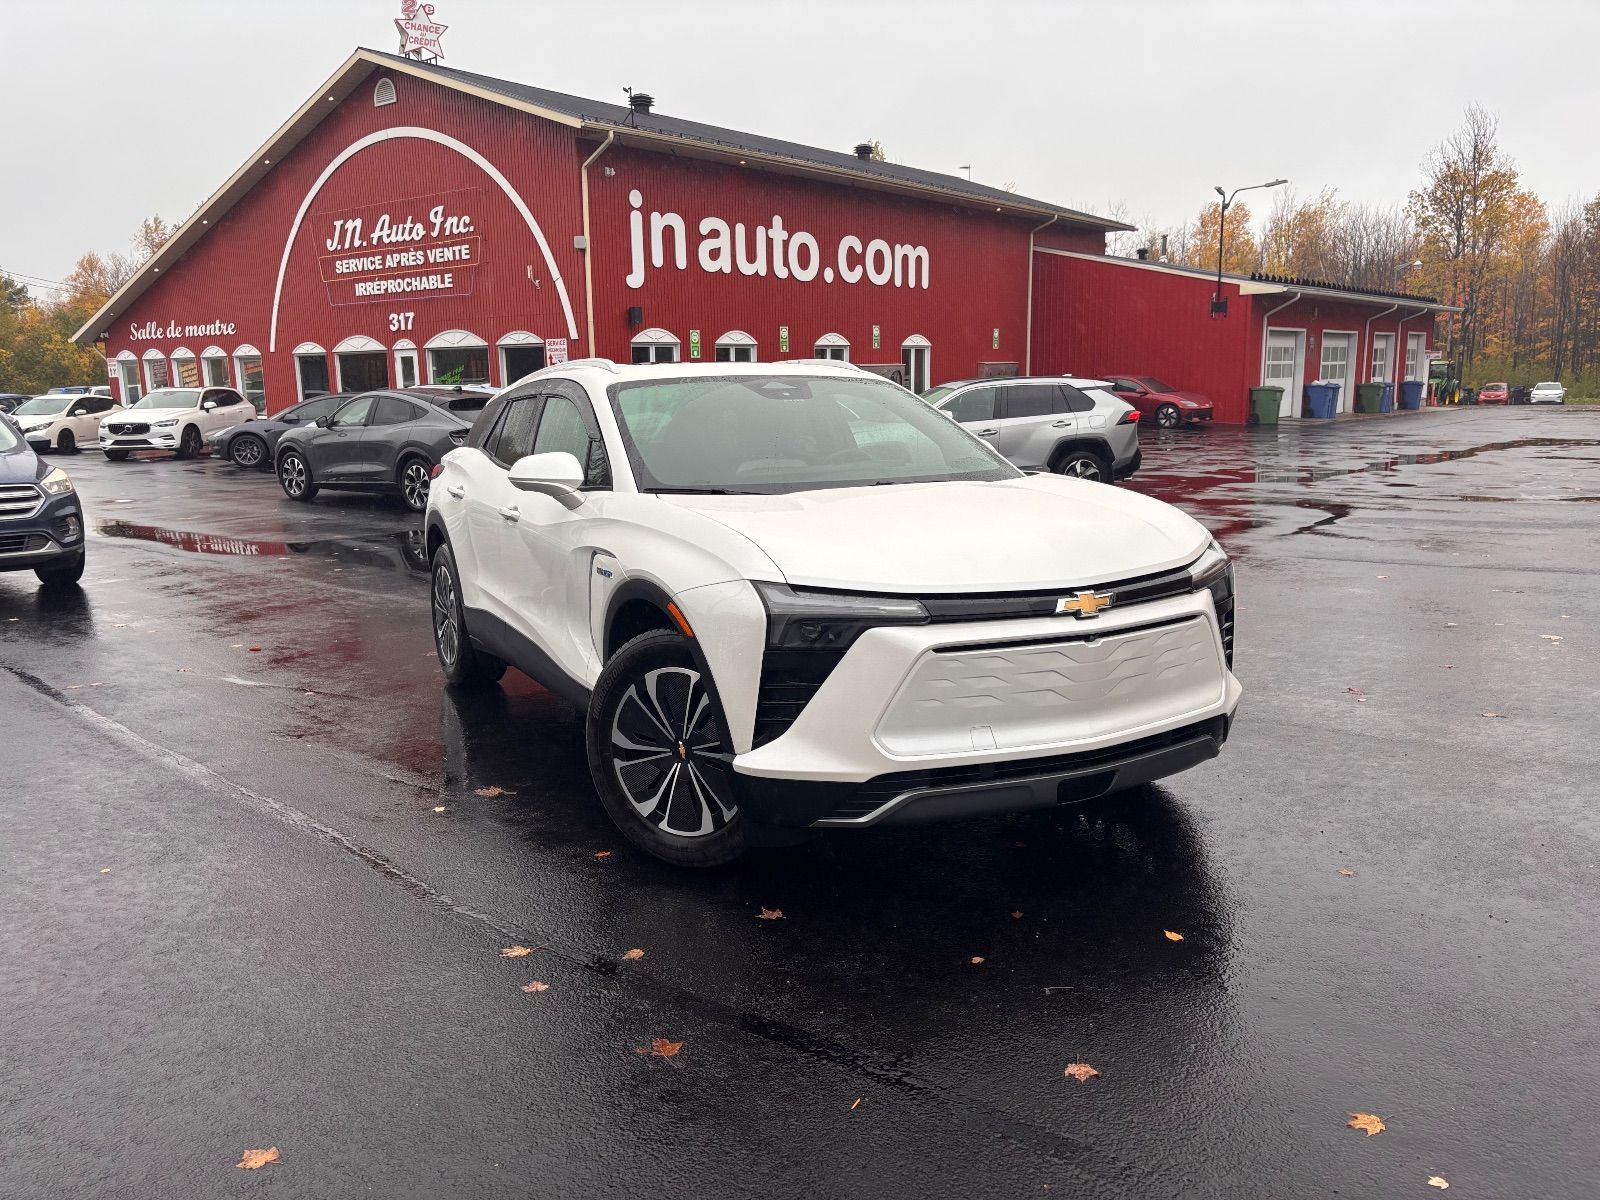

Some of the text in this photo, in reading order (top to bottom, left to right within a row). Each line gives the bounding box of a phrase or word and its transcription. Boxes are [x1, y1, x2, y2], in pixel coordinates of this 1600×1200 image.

[404, 21, 440, 34] CHANCE
[370, 213, 427, 246] Auto
[429, 205, 475, 238] Inc.
[335, 244, 470, 274] SERVICE APRÈS VENTE
[355, 274, 453, 297] IRRÉPROCHABLE
[130, 319, 237, 341] Salle de montre
[389, 312, 415, 332] 317
